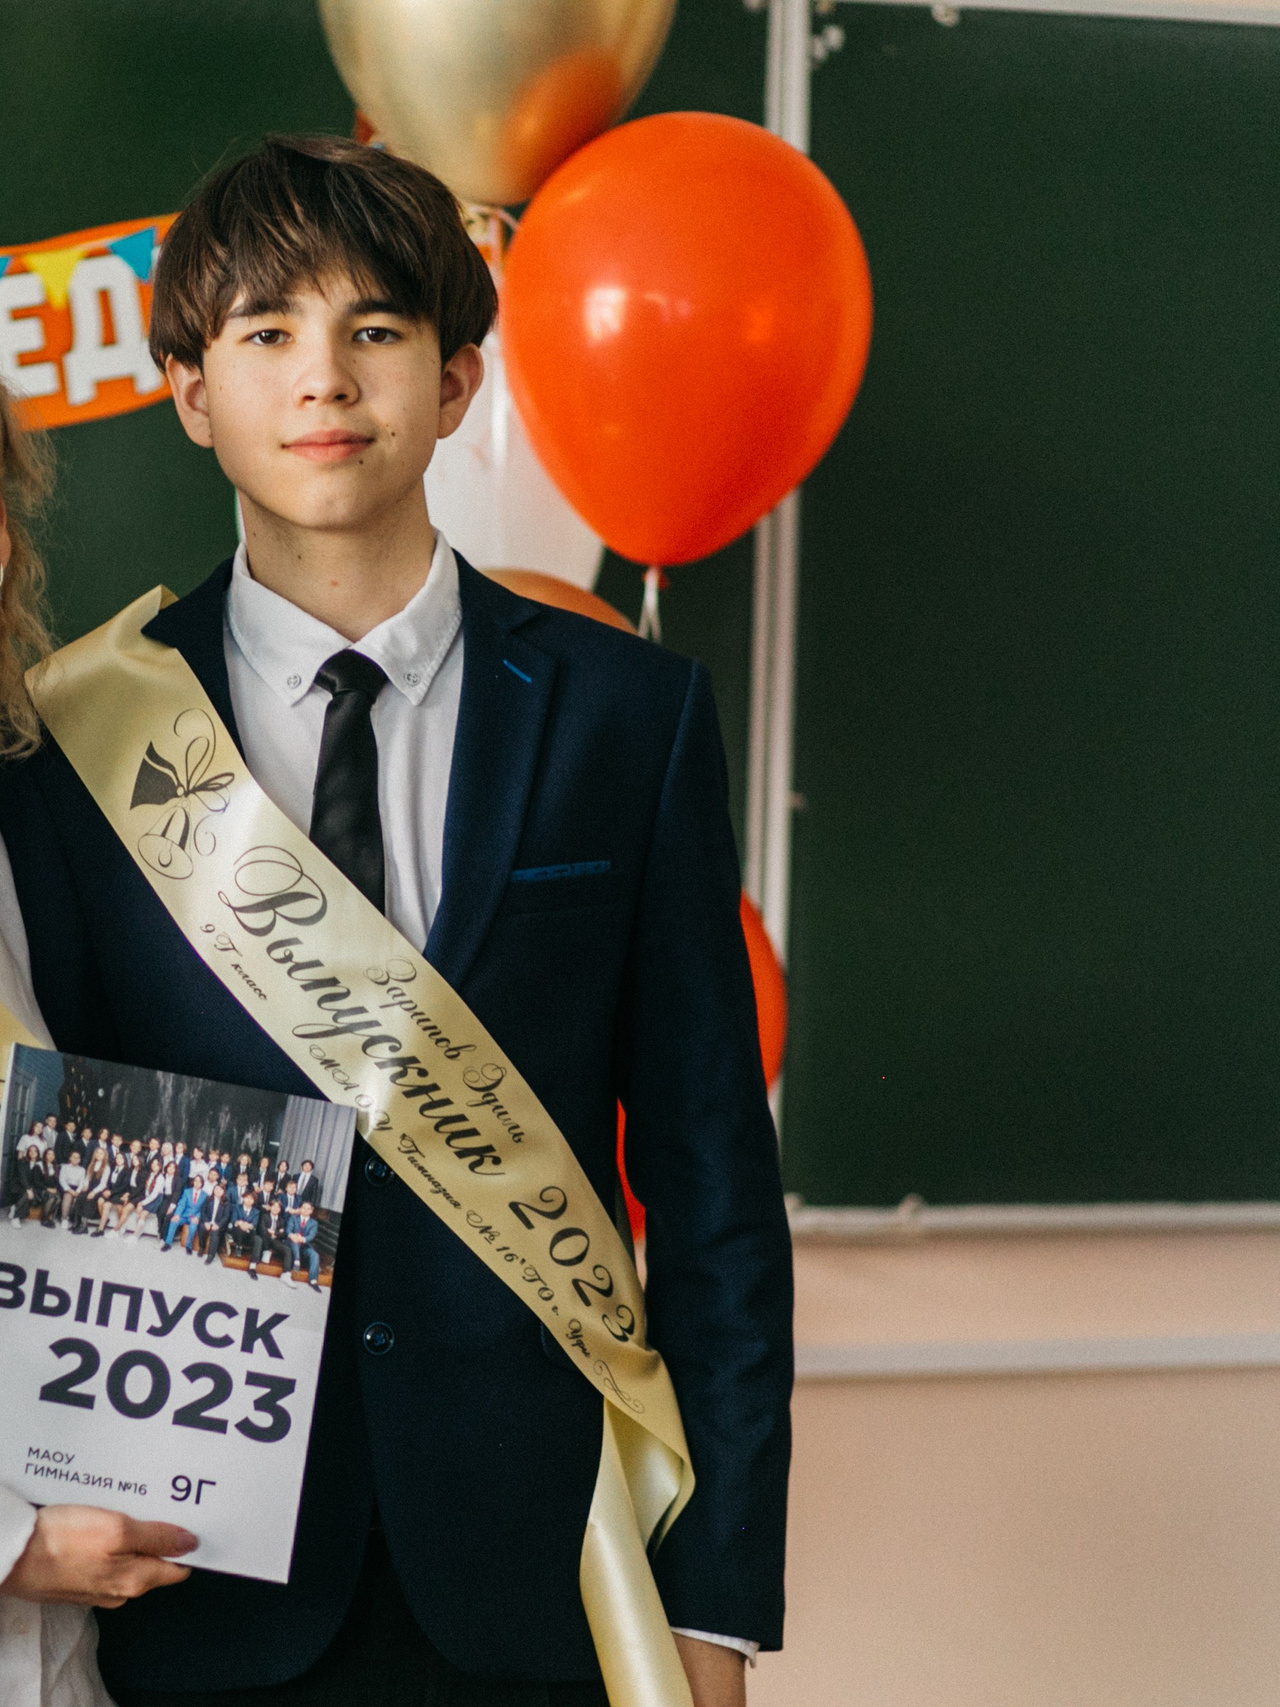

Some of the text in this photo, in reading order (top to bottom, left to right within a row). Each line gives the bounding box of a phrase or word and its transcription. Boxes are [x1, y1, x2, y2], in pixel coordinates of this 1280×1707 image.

[231, 963, 268, 1001] класс
[217, 845, 635, 1343] Выпускник 2023
[38, 1337, 297, 1444] 2023
[27, 1446, 76, 1465] МАОУ
[24, 1462, 148, 1497] ГИМНАЗИЯ №16
[170, 1474, 217, 1506] 9Г
